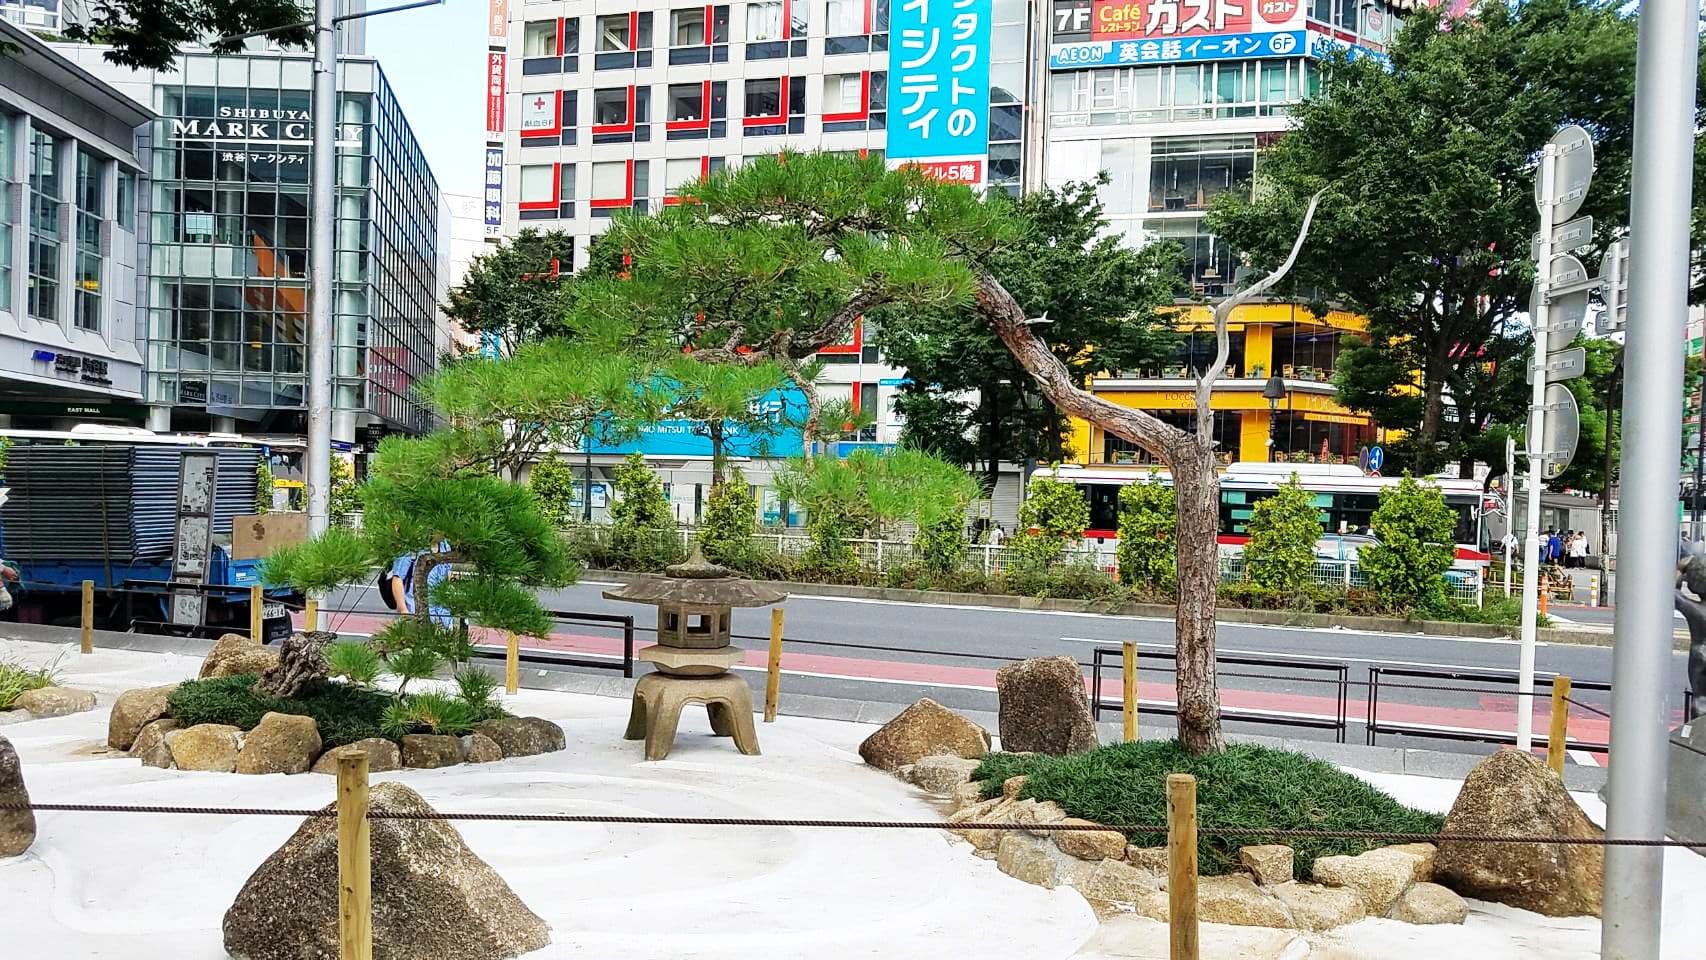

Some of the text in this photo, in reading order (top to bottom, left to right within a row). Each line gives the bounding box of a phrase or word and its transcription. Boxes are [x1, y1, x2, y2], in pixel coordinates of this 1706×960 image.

[1100, 3, 1141, 22] Café
[1263, 1, 1295, 14] ガスト
[1055, 7, 1092, 32] 7F
[1145, 0, 1243, 36] ガスト
[1100, 22, 1141, 33] レストラン
[1058, 47, 1103, 62] AEON
[1119, 37, 1293, 62] 英会話イーオン 6F
[220, 106, 310, 120] SHIBUYA
[171, 119, 364, 141] MARK CY
[222, 152, 304, 164] 渋谷 マークシティ
[486, 226, 500, 235] 5F
[657, 425, 686, 434] MITSUI
